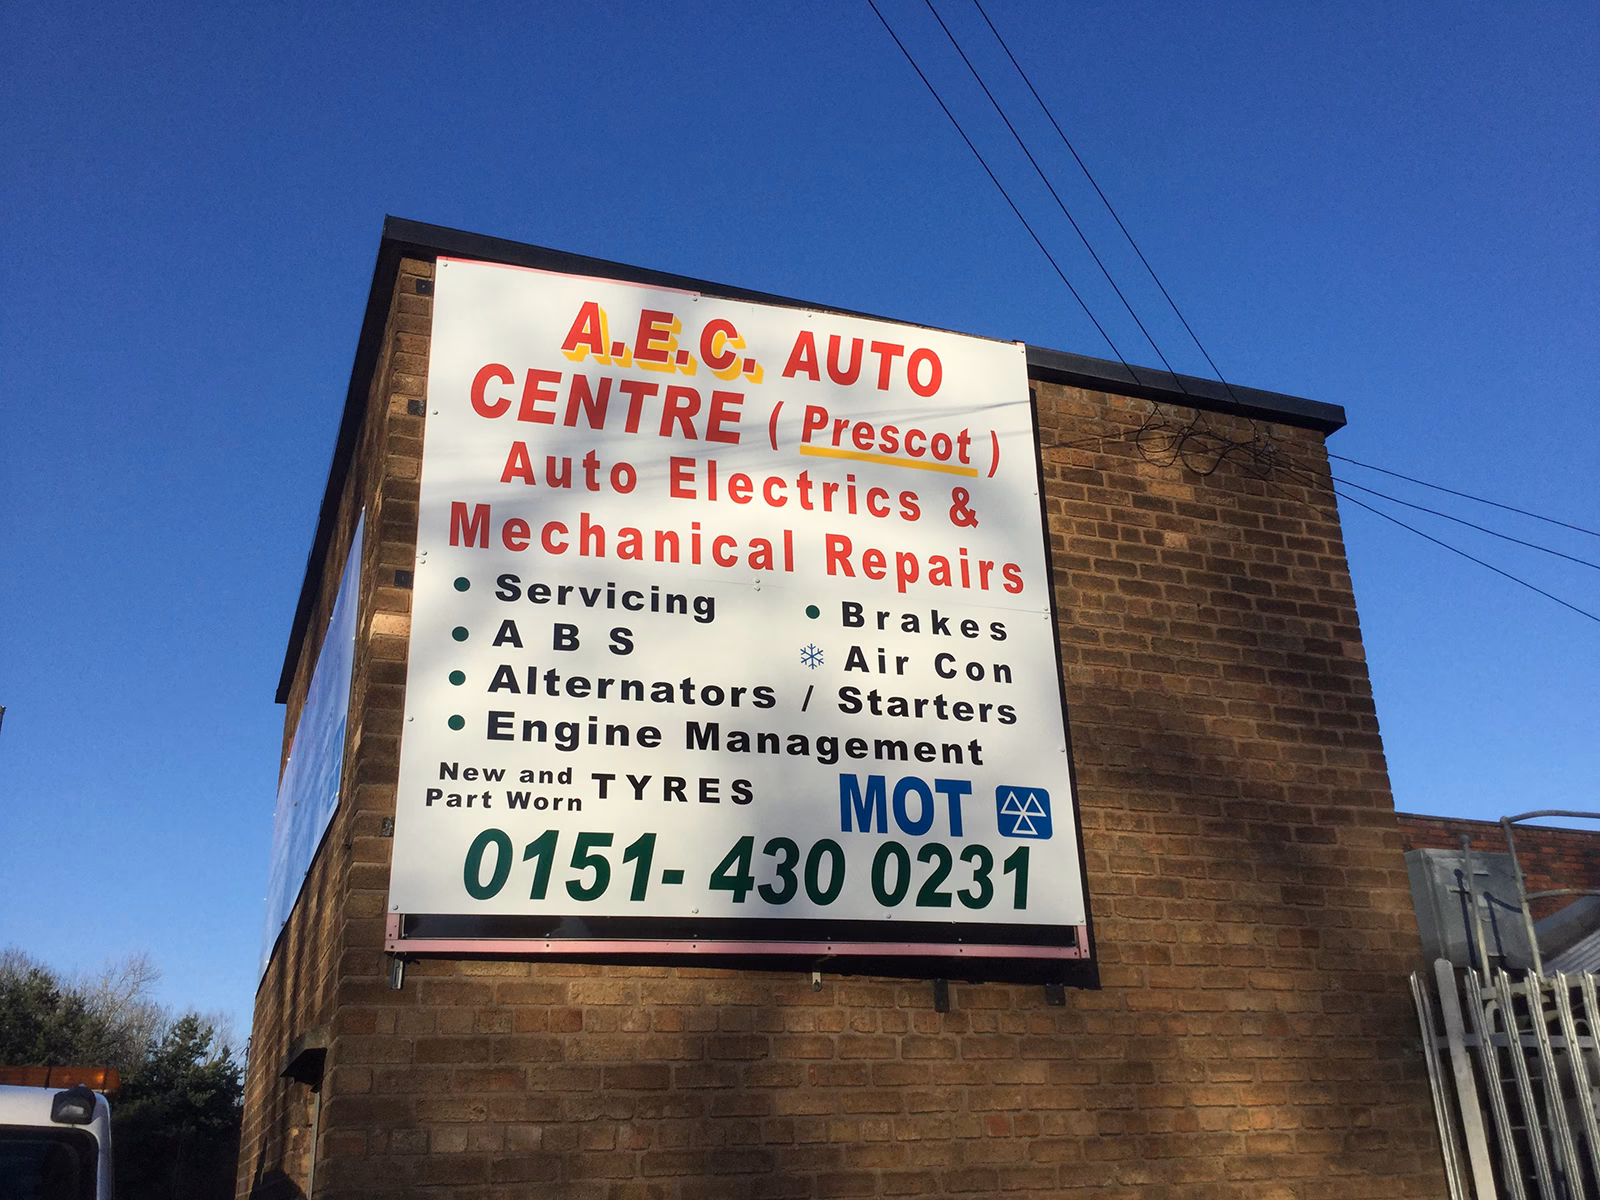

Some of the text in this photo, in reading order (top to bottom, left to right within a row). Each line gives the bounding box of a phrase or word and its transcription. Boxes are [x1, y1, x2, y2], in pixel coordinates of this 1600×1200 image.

[561, 301, 943, 397] A.E.C. AUTO
[470, 363, 745, 445] CENTRE
[500, 441, 979, 529] Auto Electrics &
[449, 501, 1024, 594] Mechanical Repairs
[495, 573, 715, 624] Servicing
[841, 601, 1007, 641] Brakes
[844, 645, 1012, 684] Air Con
[487, 664, 776, 709] Alternators
[837, 686, 1017, 725] Starters
[487, 710, 984, 766] Engine Management
[425, 788, 582, 812] Part Worn
[439, 762, 572, 785] New and
[591, 773, 754, 806] TYRES
[839, 773, 972, 837] MOT
[709, 836, 845, 906] 430
[871, 841, 1030, 910] 0231
